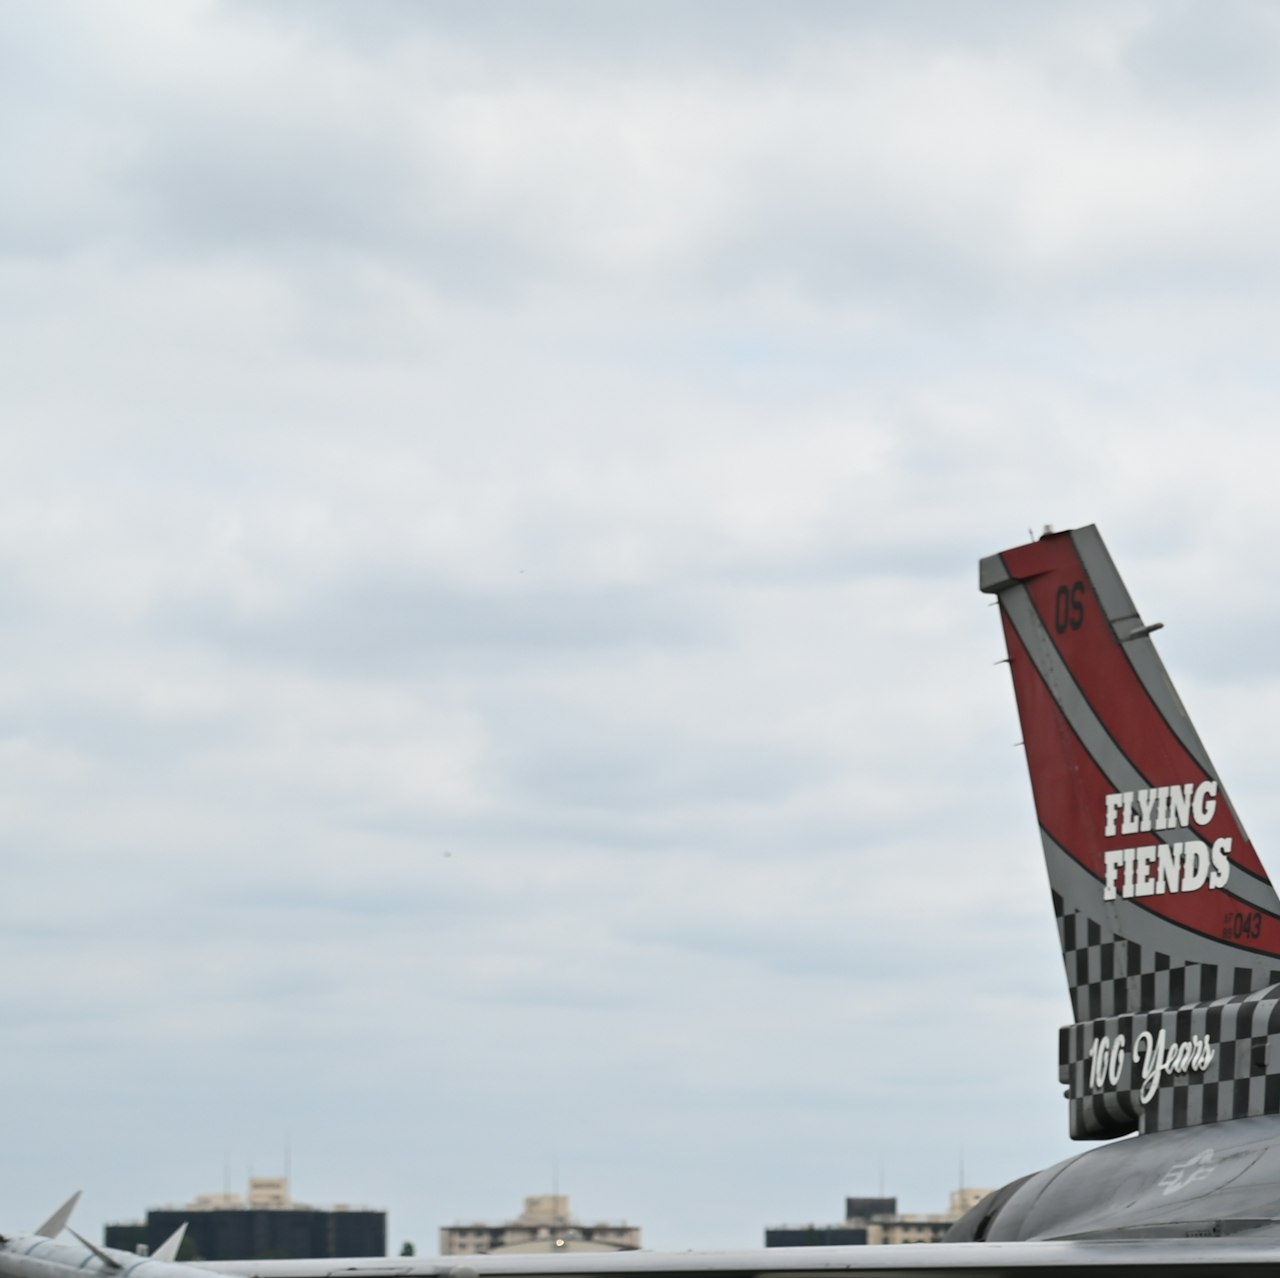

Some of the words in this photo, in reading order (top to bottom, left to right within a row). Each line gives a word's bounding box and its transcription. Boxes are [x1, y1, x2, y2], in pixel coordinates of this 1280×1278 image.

[1056, 581, 1085, 634] OS
[1104, 780, 1218, 837] FLYING
[1103, 837, 1233, 901] FIENDS
[1234, 911, 1262, 939] 043
[1132, 1028, 1215, 1105] Years
